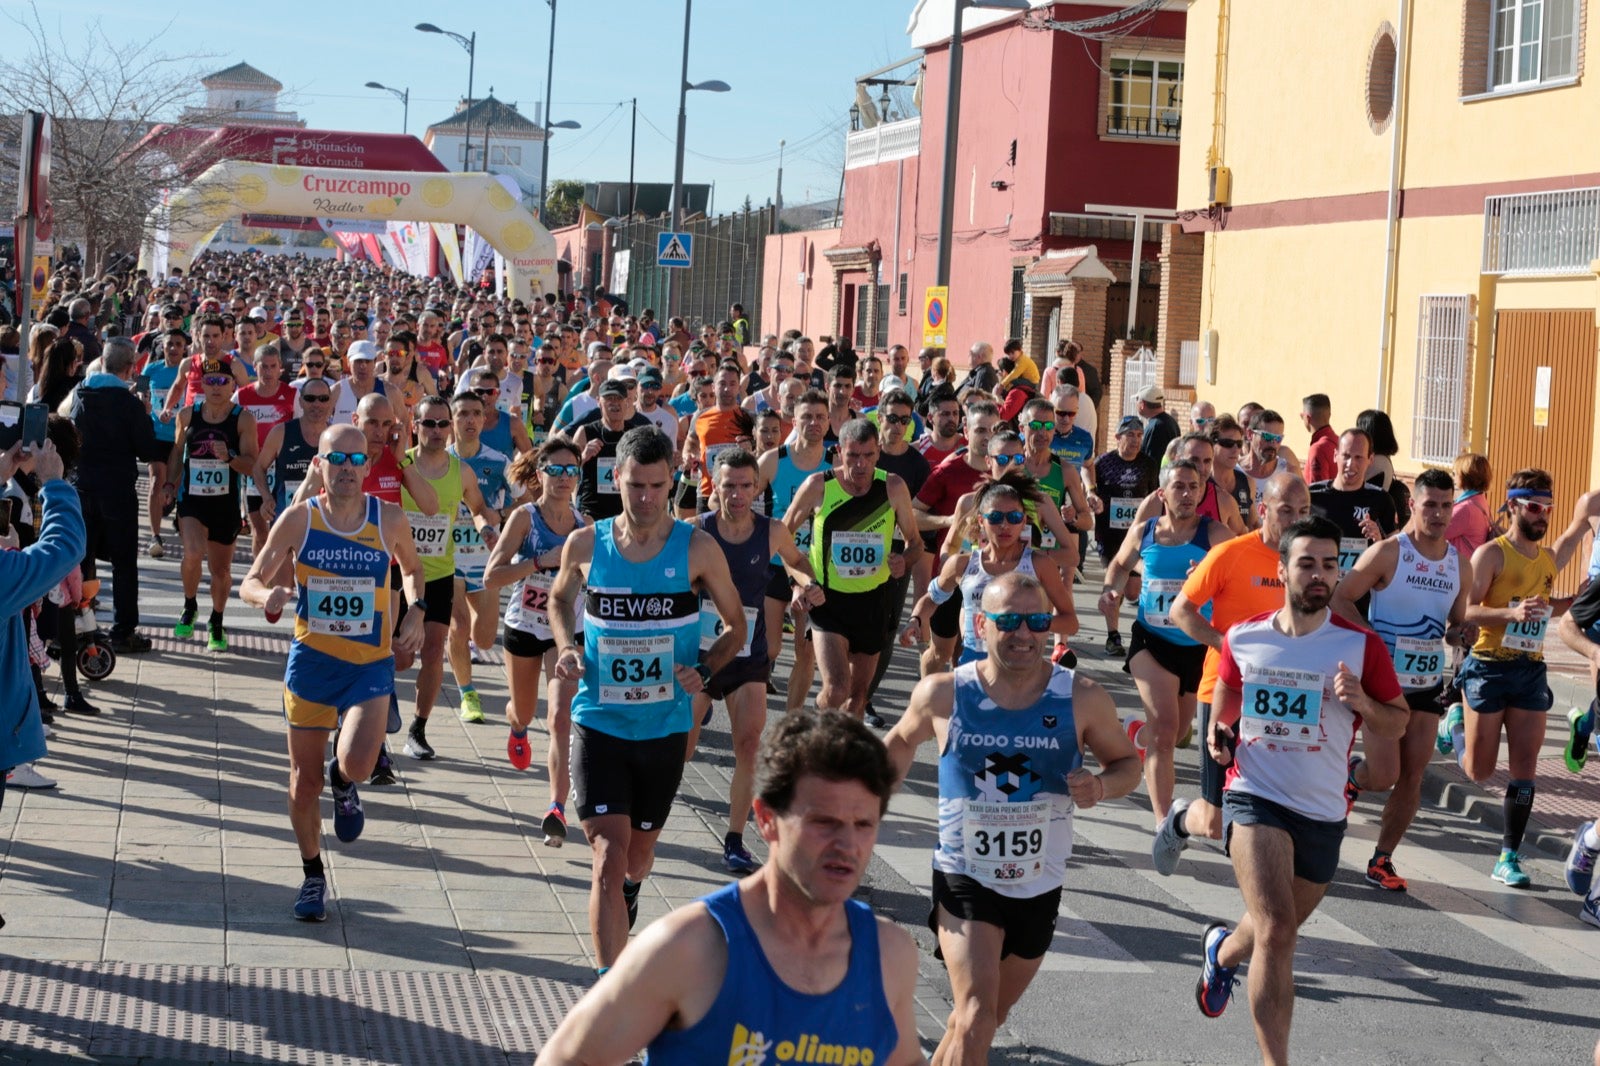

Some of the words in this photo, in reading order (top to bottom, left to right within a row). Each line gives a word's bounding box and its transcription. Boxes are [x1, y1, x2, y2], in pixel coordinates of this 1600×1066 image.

[302, 139, 365, 154] Diputación
[301, 153, 314, 165] de
[316, 155, 364, 168] Granada
[303, 174, 411, 197] Cruzcampo
[313, 198, 365, 214] Radler
[196, 471, 223, 484] 470
[411, 527, 445, 543] 3097
[452, 528, 480, 543] 617
[307, 547, 381, 564] agustinos
[840, 546, 876, 564] 808
[318, 562, 370, 571] GRANADA
[1406, 575, 1454, 591] MARACENA
[318, 595, 364, 617] 499
[611, 657, 662, 683] 634
[1404, 653, 1439, 673] 758
[1254, 688, 1308, 719] 834
[961, 733, 1009, 748] TODO
[1014, 735, 1060, 750] SUMA
[985, 805, 999, 813] GRAN
[1001, 805, 1022, 814] PREMIO
[1022, 805, 1030, 813] DE
[974, 828, 1043, 857] 3159
[775, 1033, 874, 1066] olimpo
